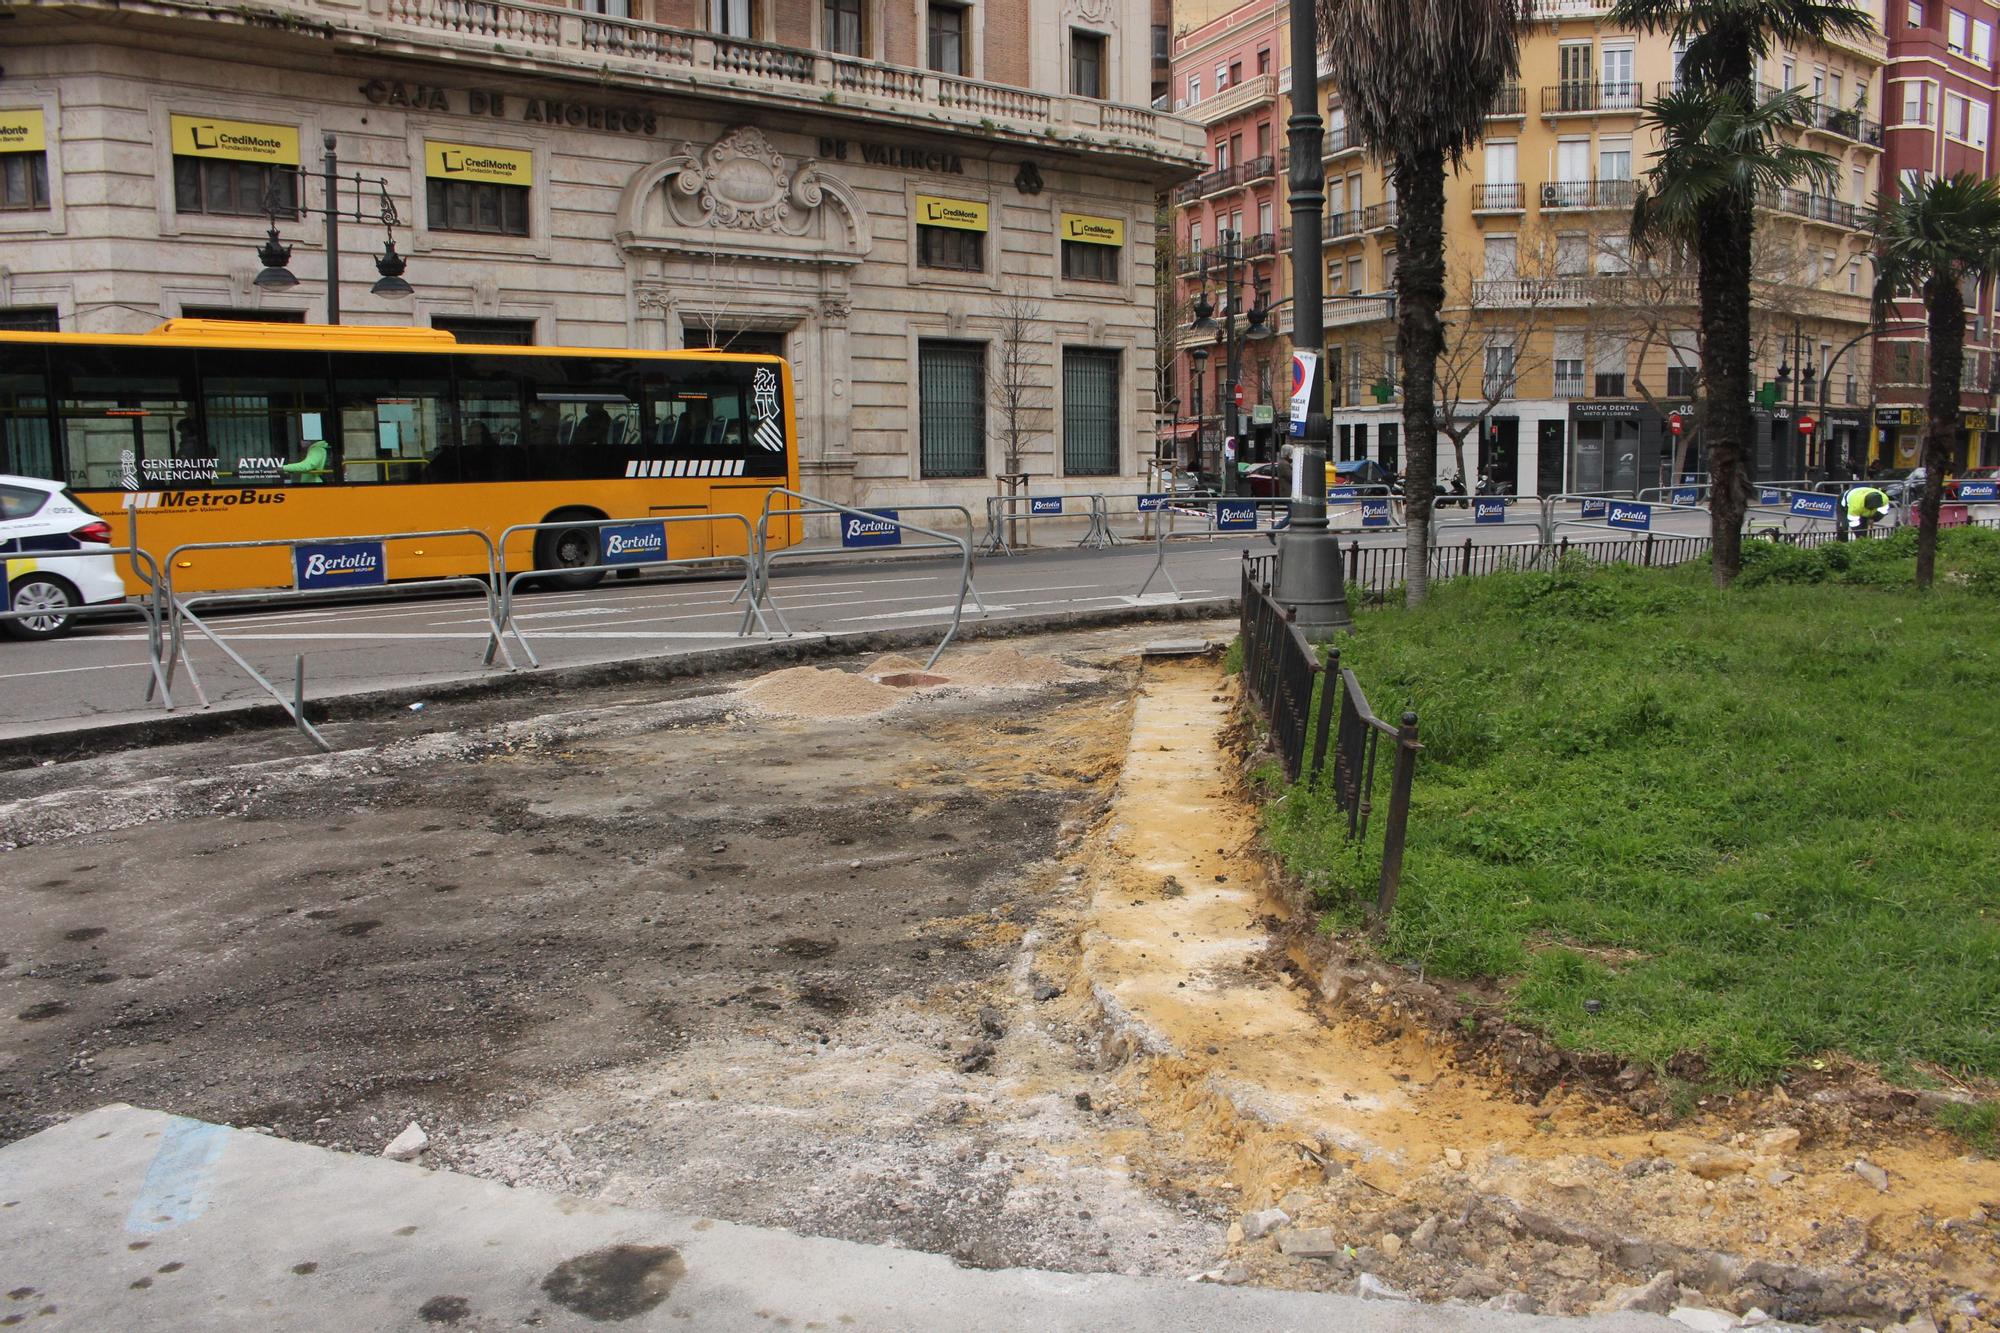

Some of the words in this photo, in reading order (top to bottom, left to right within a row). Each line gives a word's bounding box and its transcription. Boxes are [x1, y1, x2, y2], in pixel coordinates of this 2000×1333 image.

[365, 80, 449, 111] CAJA
[469, 90, 505, 117] DE
[523, 101, 657, 135] AHORROS
[219, 133, 281, 148] CrediMonte
[465, 158, 517, 171] CrediMonte
[860, 142, 964, 174] VALENCIA
[942, 208, 978, 219] CrediMonte
[1083, 225, 1115, 235] CrediMonte
[141, 458, 219, 469] GENERALITAT
[238, 457, 285, 468] ATMV
[143, 470, 219, 481] VALENCIANA
[160, 487, 286, 507] MetroBus
[1610, 508, 1647, 522] Bertolín
[607, 533, 662, 557] Bertolín
[304, 551, 377, 580] Bertolín
